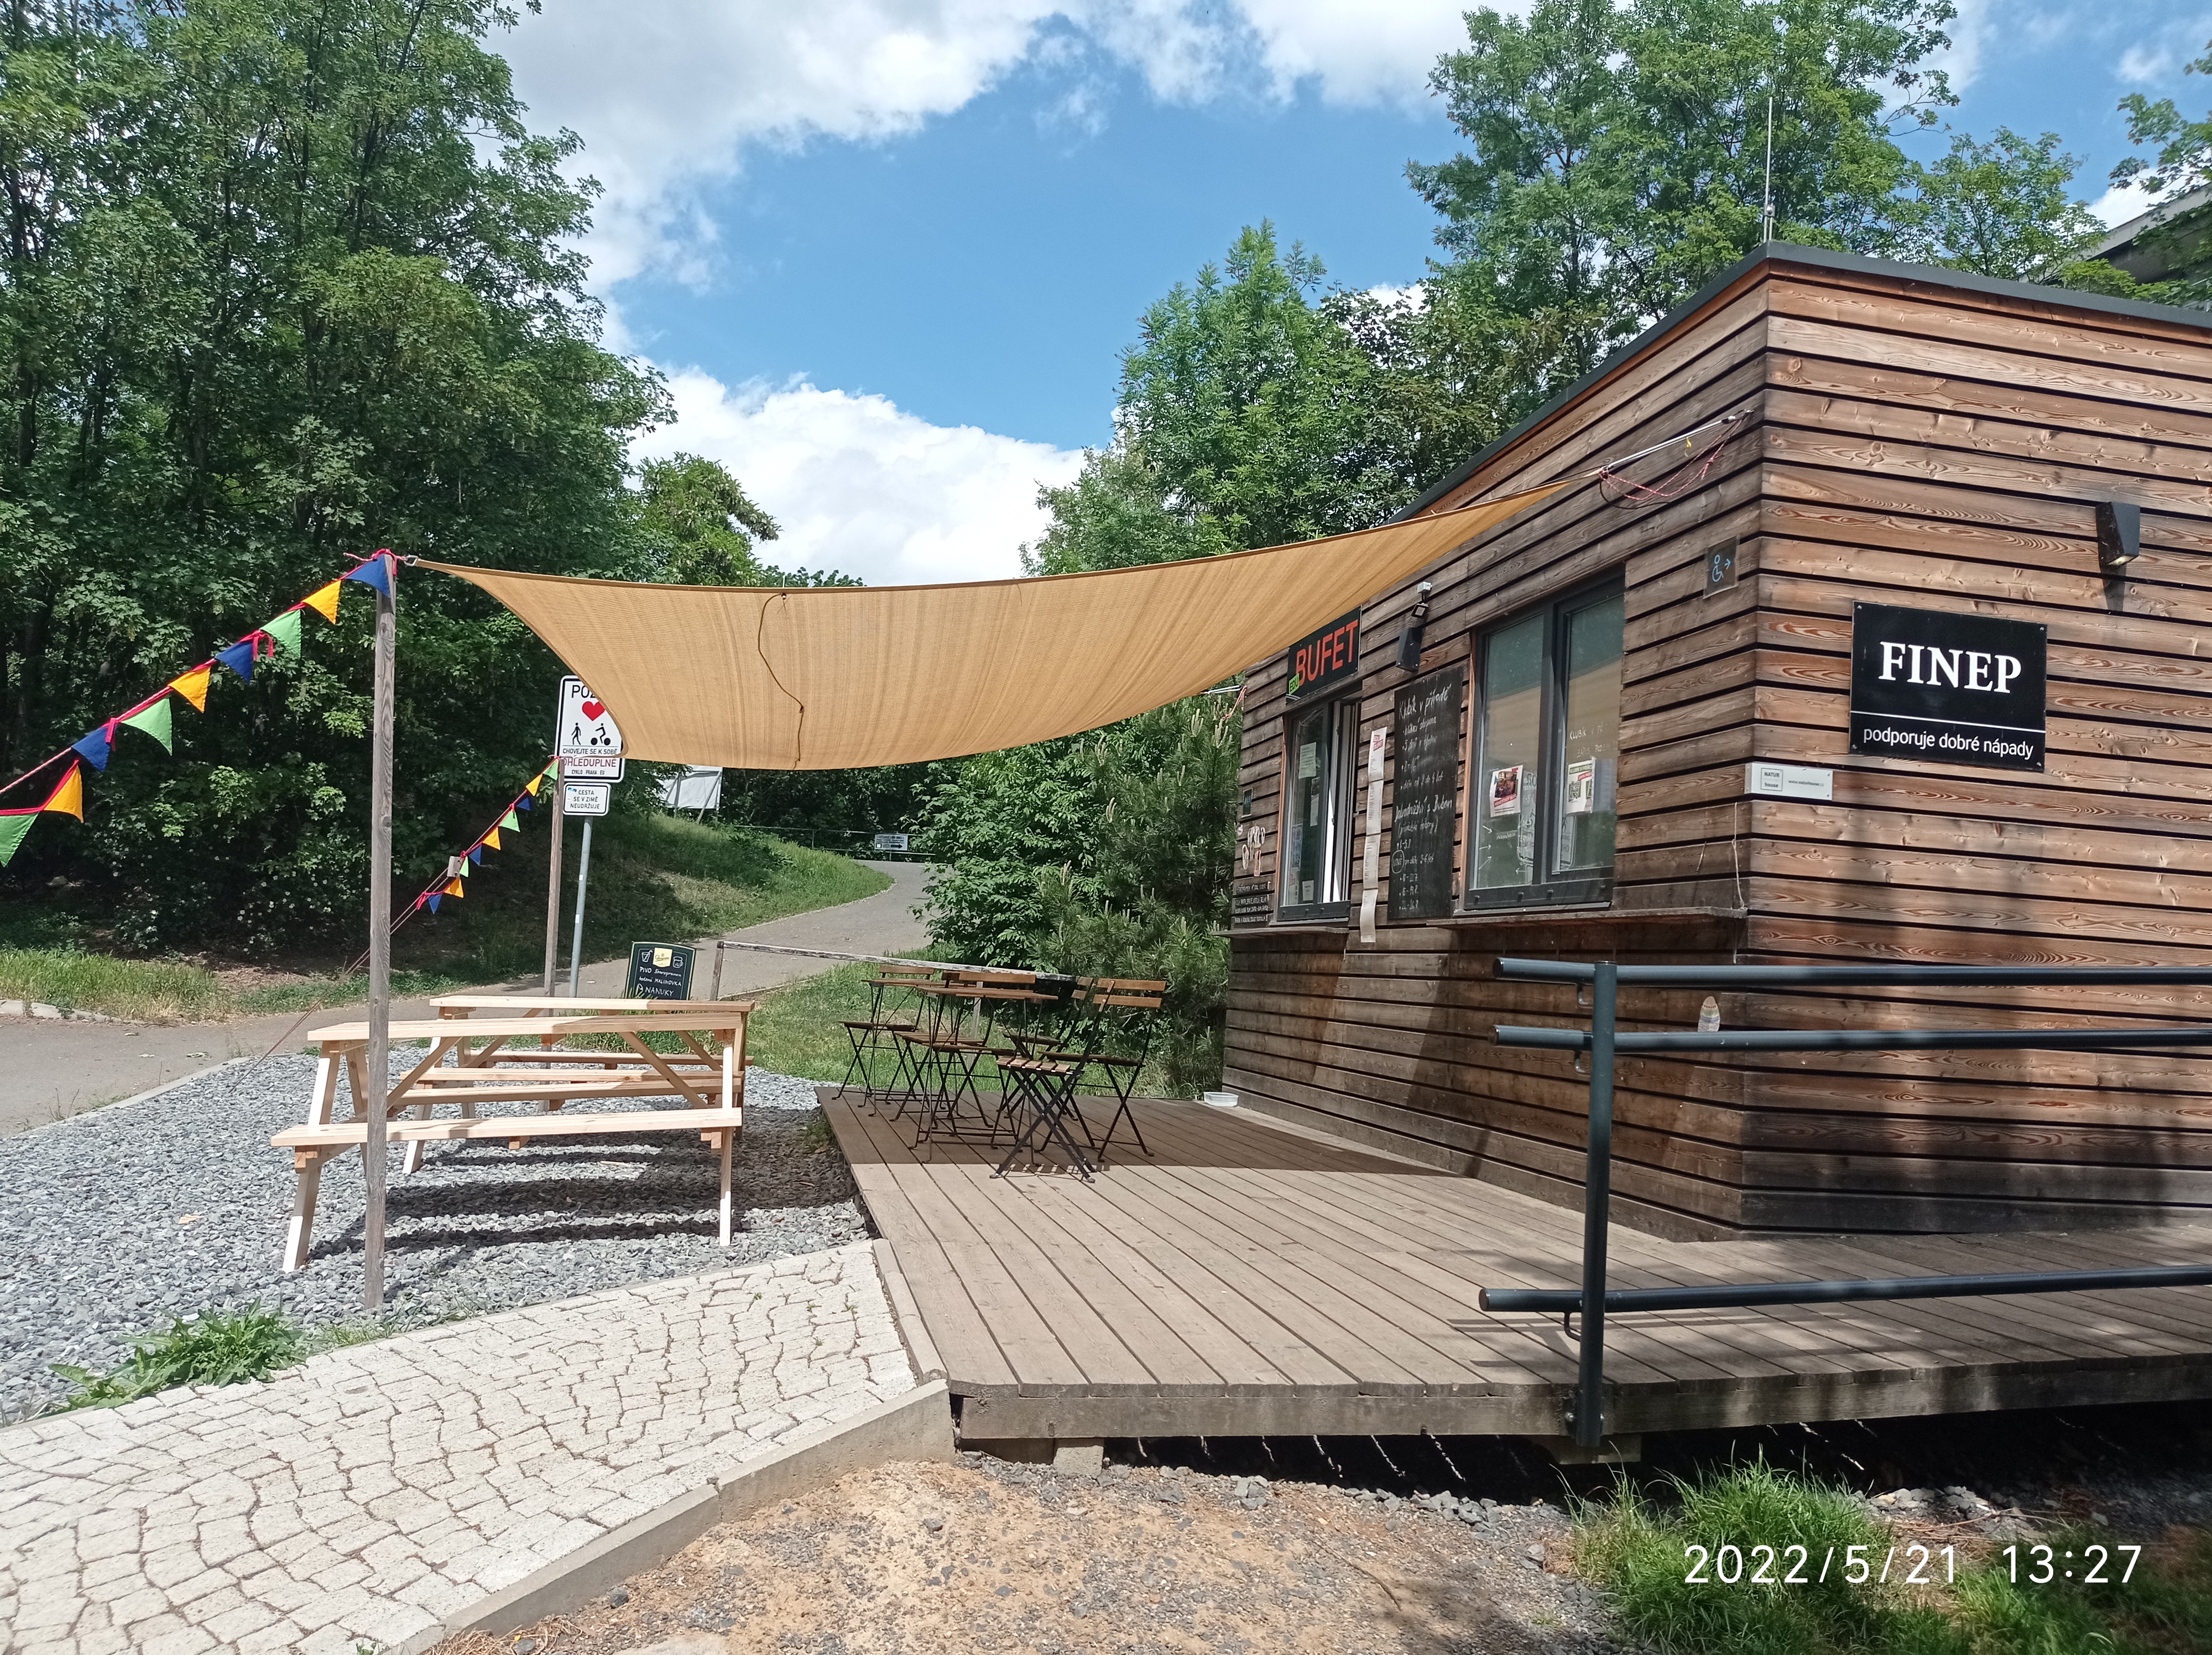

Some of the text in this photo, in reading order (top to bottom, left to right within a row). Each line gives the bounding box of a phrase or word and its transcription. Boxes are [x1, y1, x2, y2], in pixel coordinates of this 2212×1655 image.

[1296, 620, 1359, 686] BUFET
[1878, 641, 2022, 694] FINEP
[1290, 676, 1299, 692] EDU
[1864, 727, 2034, 760] podporuje dobré nápady
[645, 986, 674, 997] NANUKY
[654, 978, 682, 986] MALINOVKA
